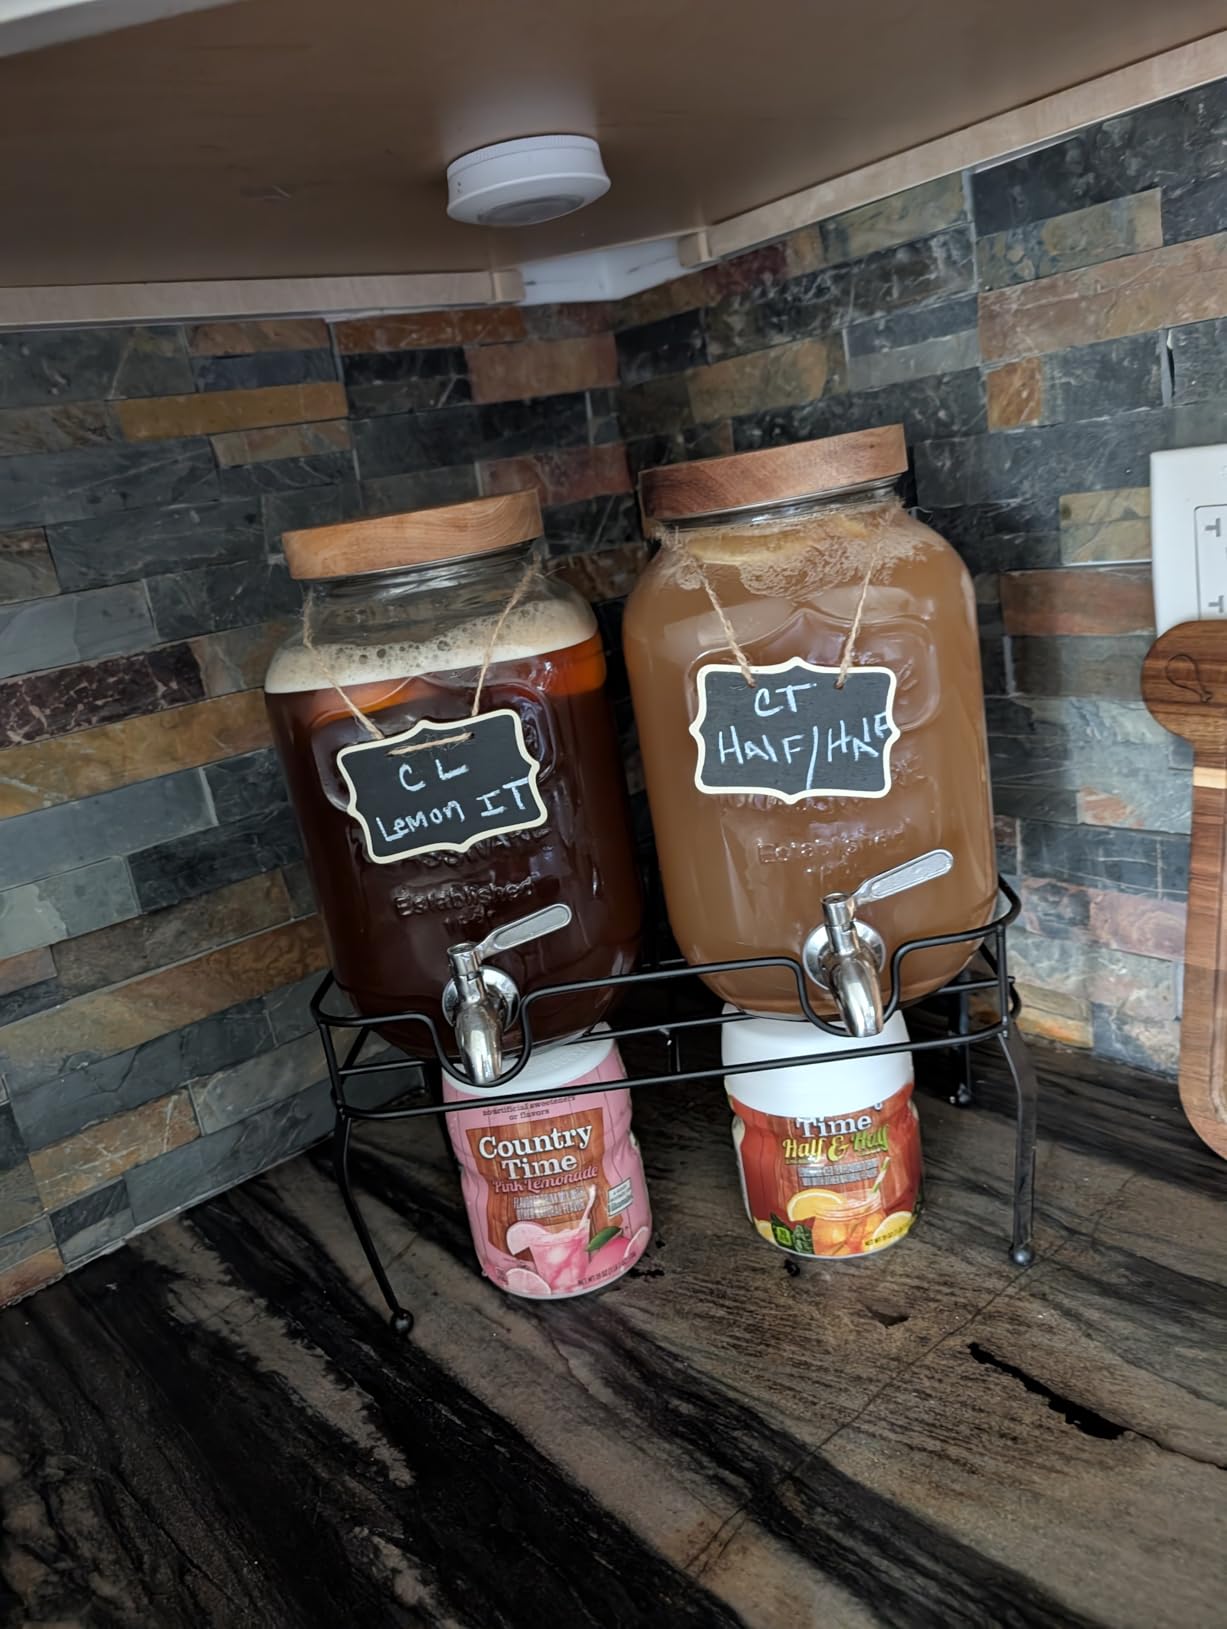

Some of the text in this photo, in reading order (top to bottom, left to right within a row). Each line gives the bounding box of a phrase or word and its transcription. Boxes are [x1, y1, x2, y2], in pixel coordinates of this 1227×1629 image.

[754, 682, 818, 717] CT
[476, 777, 529, 817] IT
[478, 1125, 593, 1160] Country
[782, 1125, 888, 1163] Half & Half
[796, 1115, 873, 1138] Time
[494, 1165, 599, 1194] Pink Lemonade
[502, 1154, 578, 1181] Time
